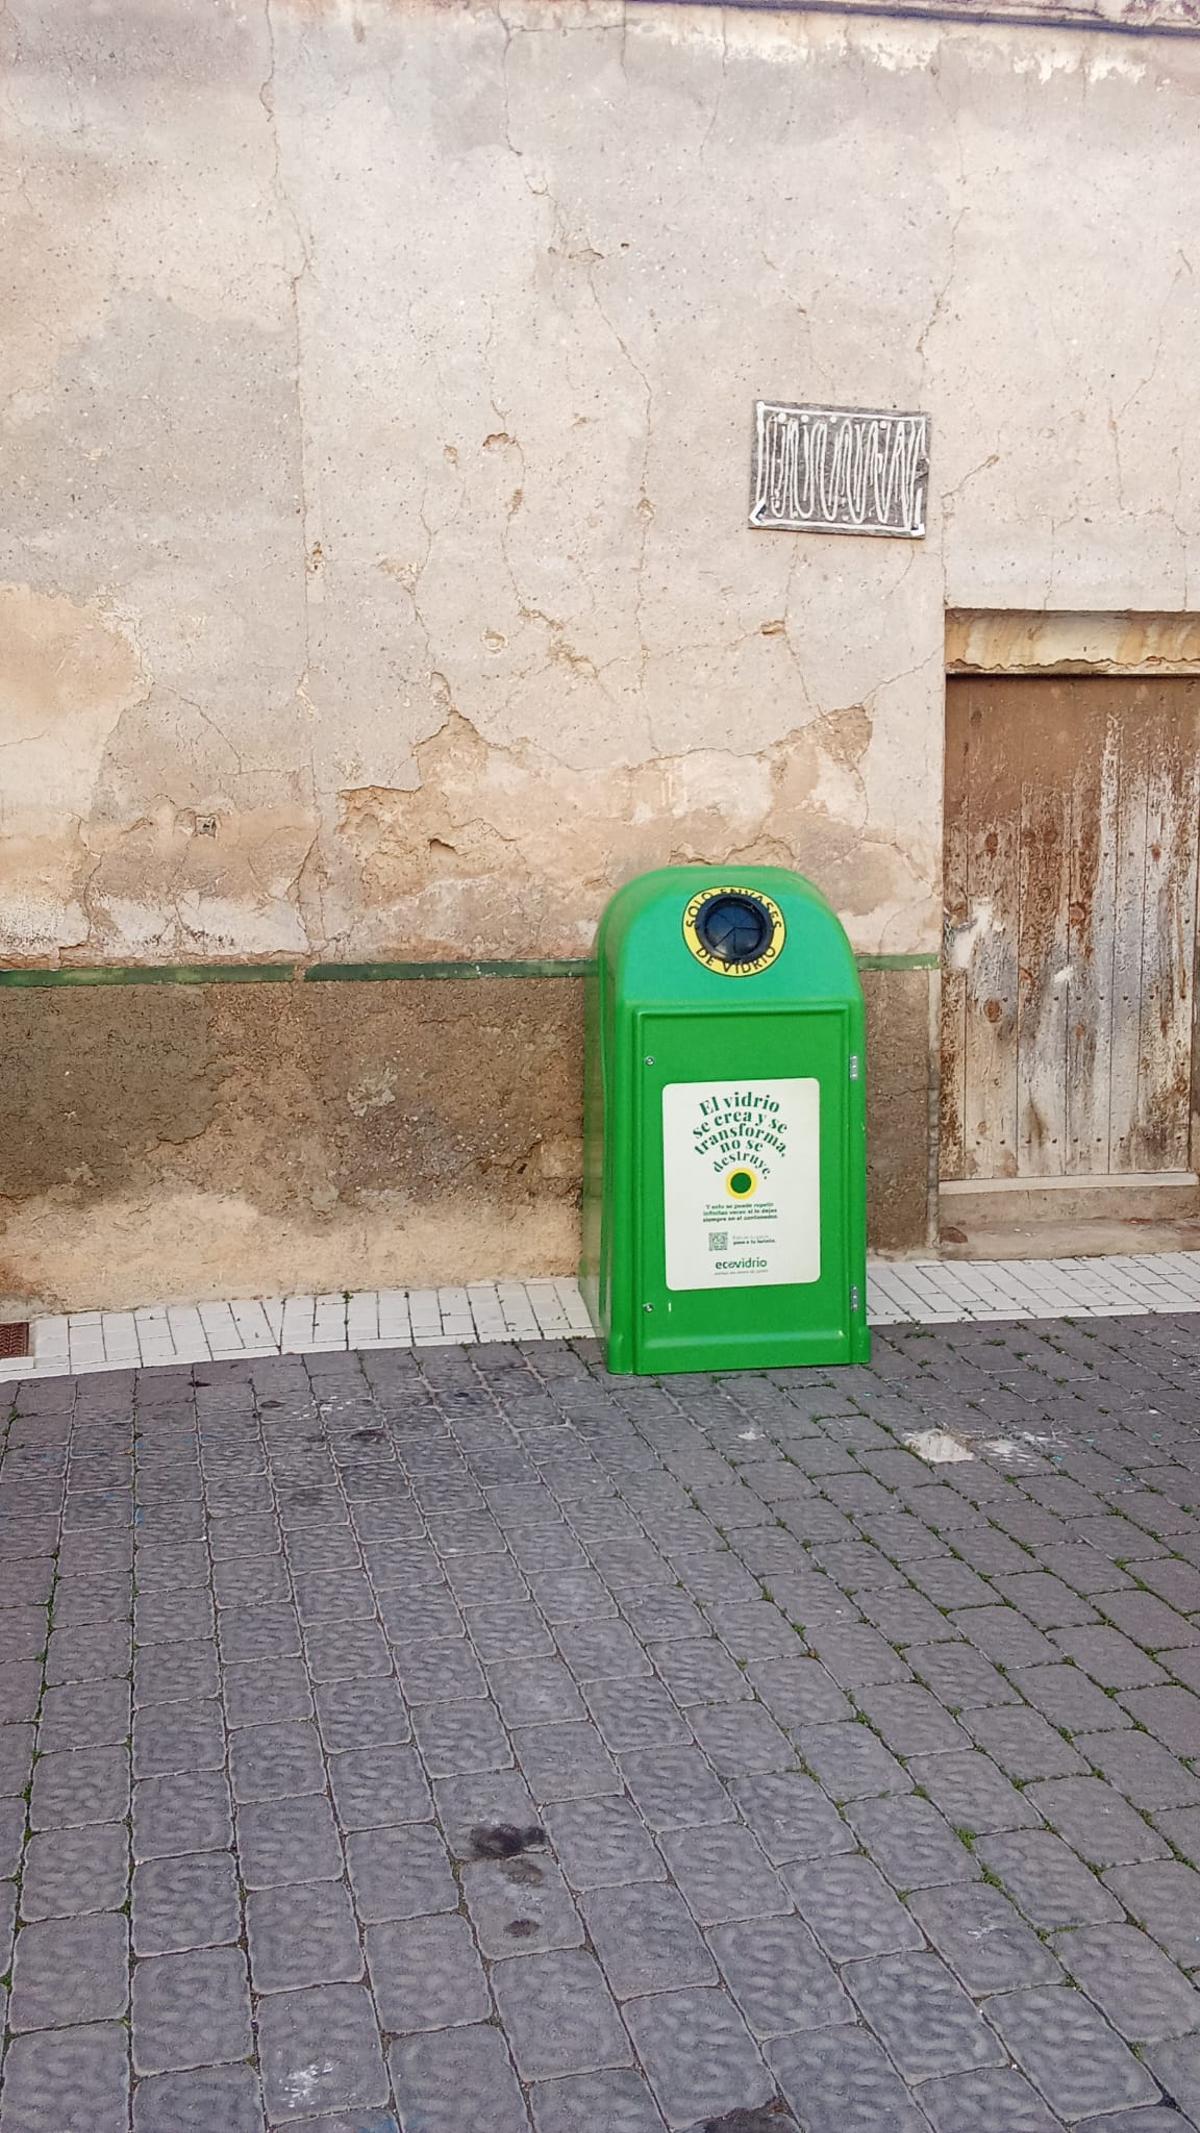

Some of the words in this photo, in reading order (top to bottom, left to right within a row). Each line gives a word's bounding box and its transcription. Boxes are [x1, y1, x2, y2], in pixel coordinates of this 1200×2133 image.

[686, 892, 713, 928] SOLO
[696, 946, 715, 967] DE
[721, 946, 776, 974] VIDRIO
[699, 1096, 720, 1116] El
[723, 1091, 780, 1113] vidrio
[693, 1121, 711, 1139] se
[714, 1111, 752, 1126] crea
[755, 1113, 767, 1126] y
[768, 1118, 787, 1134] se
[720, 1139, 741, 1153] no
[745, 1139, 763, 1152] se
[713, 1151, 771, 1180] destruye.
[715, 1257, 767, 1269] ecovidrio
